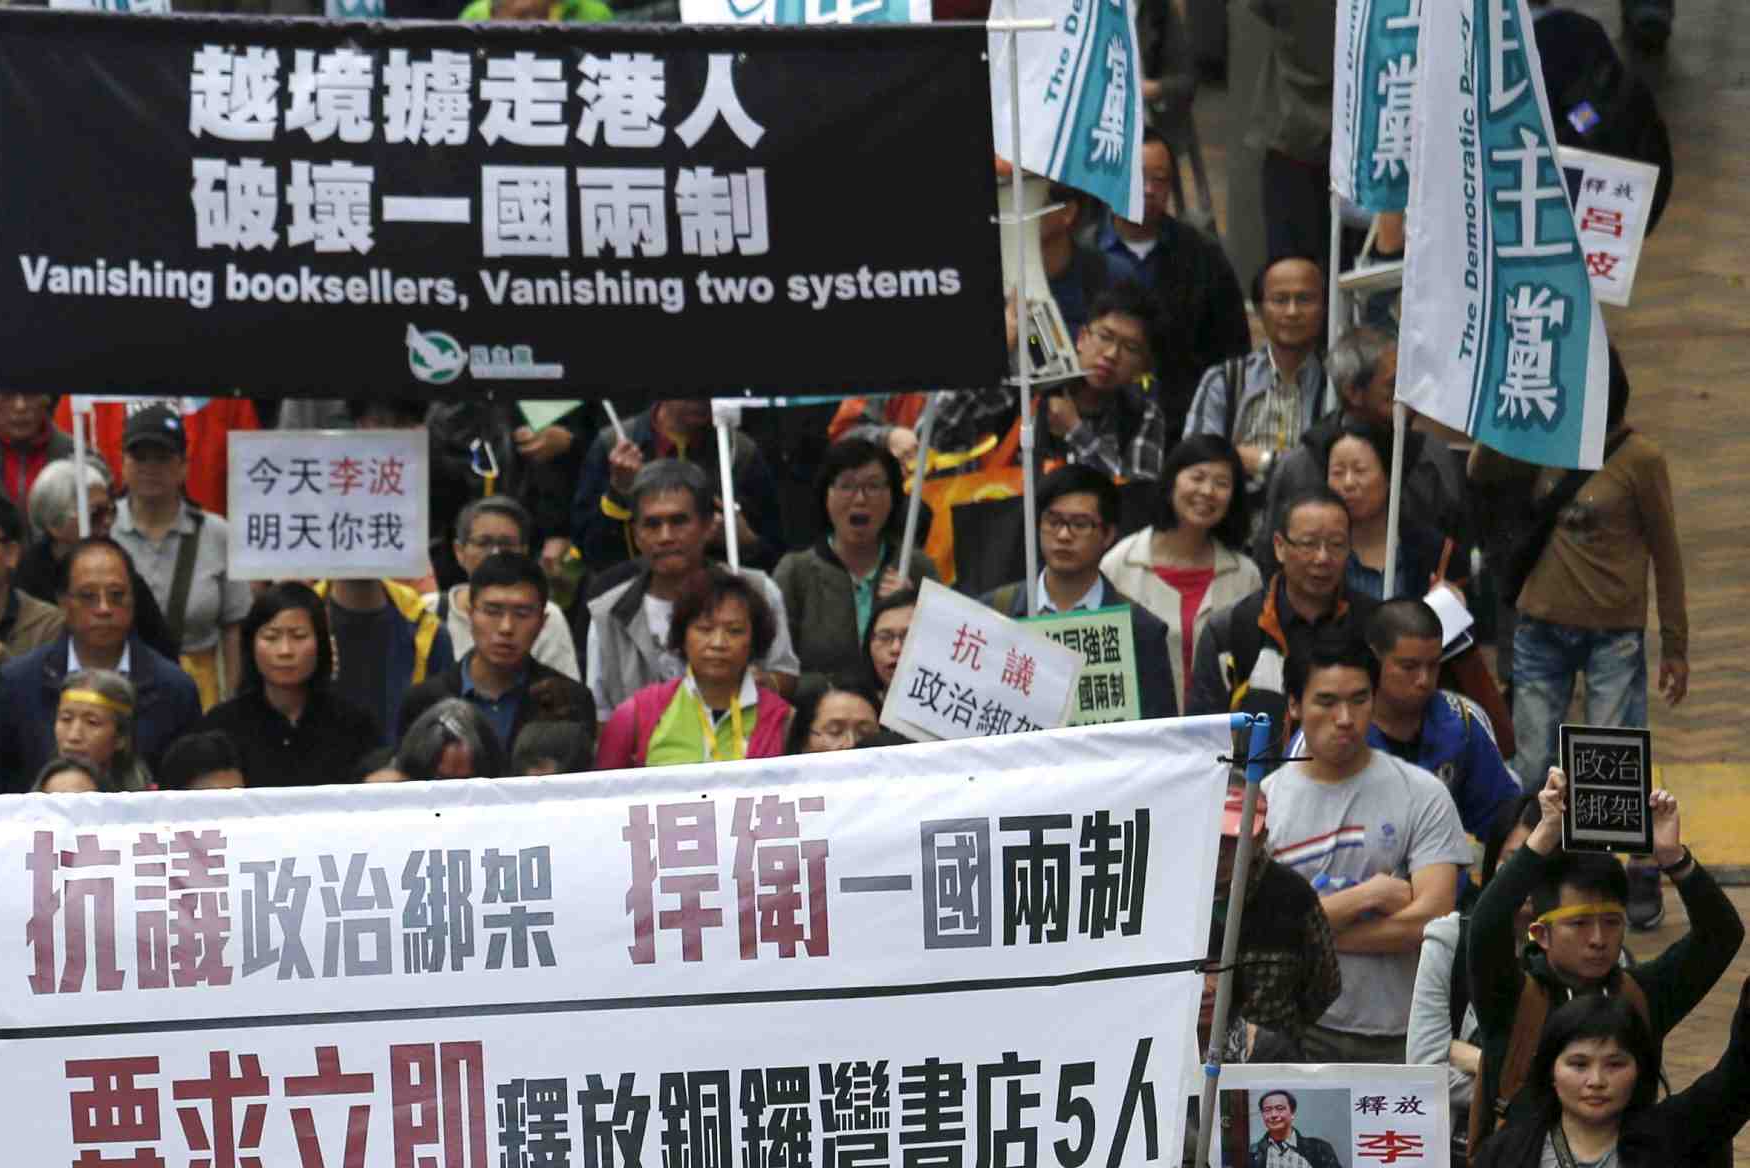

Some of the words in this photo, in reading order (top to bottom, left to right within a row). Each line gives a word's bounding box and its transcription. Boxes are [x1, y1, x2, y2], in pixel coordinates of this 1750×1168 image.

[189, 45, 766, 148] 越境擄走港人
[1044, 43, 1073, 105] The
[190, 158, 769, 257] 破壞一國兩制
[1458, 104, 1479, 290] Democratic
[19, 255, 213, 308] Vanishing
[226, 263, 468, 310] booksellers,
[479, 268, 684, 313] Vanishing
[697, 270, 774, 303] two
[786, 264, 961, 310] systems
[1459, 303, 1478, 360] The
[247, 456, 405, 496] 今天李波
[247, 512, 405, 551] 明天你我
[950, 623, 1035, 697] 抗議
[1576, 749, 1640, 780] 政治
[1577, 793, 1641, 826] 綁架
[25, 829, 557, 995] 抗議政治綁架
[621, 795, 1152, 966] 捍衛一國兩制
[1355, 1095, 1427, 1117] 釋放
